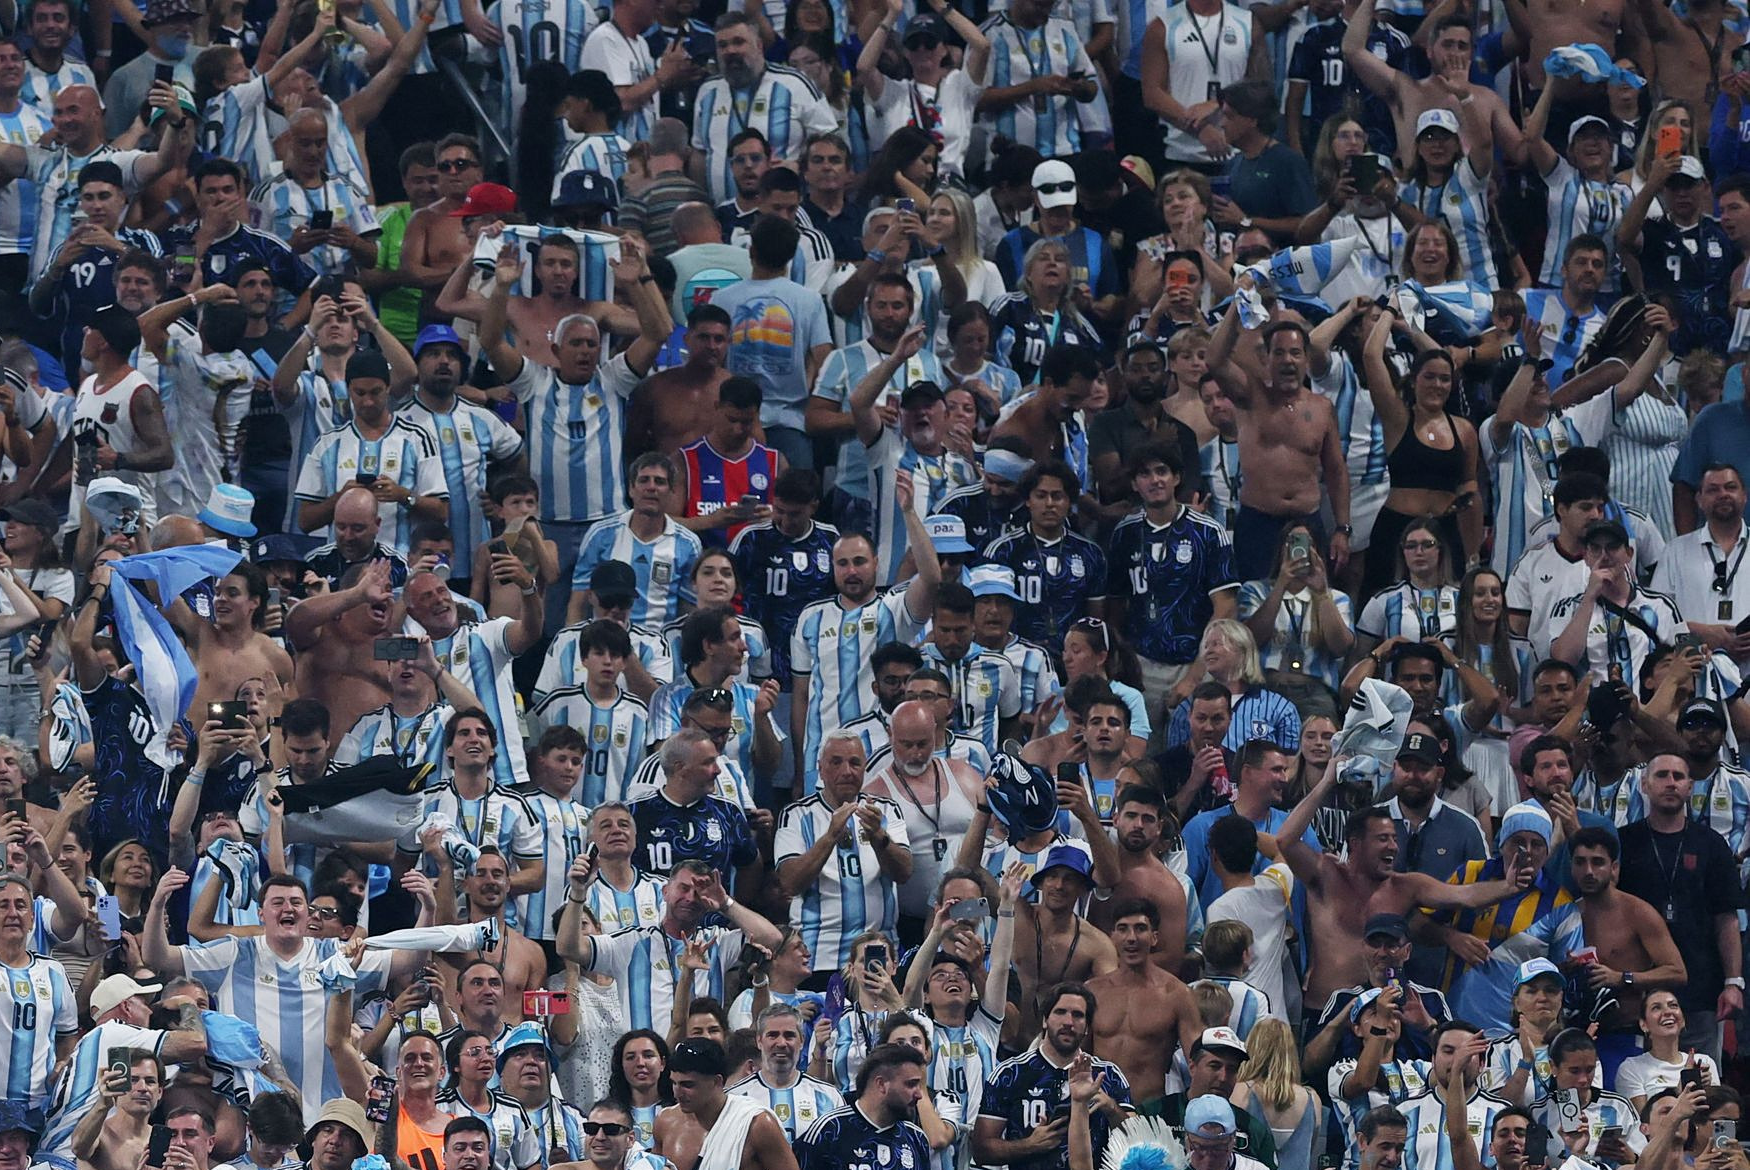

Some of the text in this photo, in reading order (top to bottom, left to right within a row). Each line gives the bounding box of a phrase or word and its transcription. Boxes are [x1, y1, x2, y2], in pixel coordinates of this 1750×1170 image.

[1321, 58, 1344, 87] 10
[70, 261, 96, 289] 19
[1268, 260, 1305, 281] MESS
[1666, 254, 1681, 282] 9
[1025, 336, 1046, 366] 10
[933, 524, 954, 535] pax
[765, 567, 788, 597] 10
[1017, 575, 1042, 604] 10
[127, 712, 151, 745] 10
[586, 749, 609, 776] 10
[646, 841, 673, 871] 10
[838, 853, 862, 878] 10
[12, 1002, 37, 1031] 10
[1021, 1098, 1047, 1129] 10
